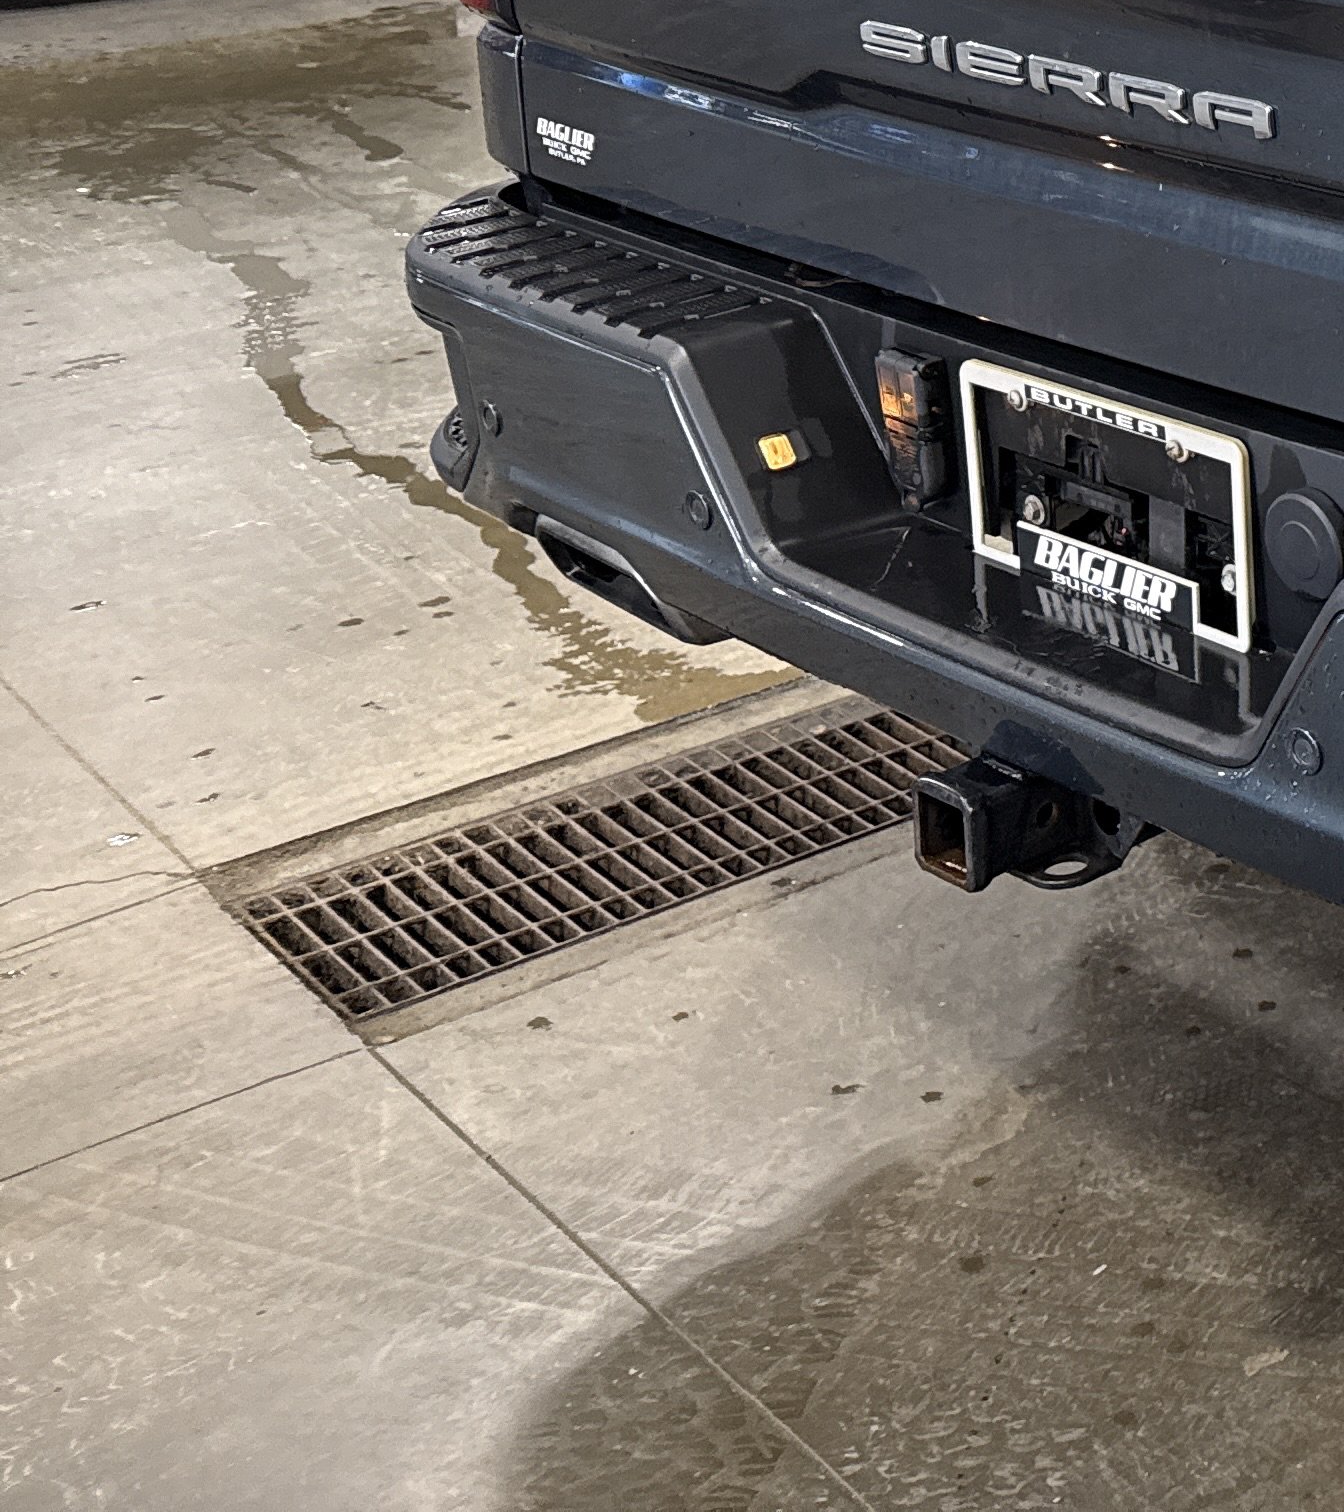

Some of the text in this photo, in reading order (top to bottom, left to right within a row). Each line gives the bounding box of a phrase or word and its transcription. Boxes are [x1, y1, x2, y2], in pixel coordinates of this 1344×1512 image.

[860, 20, 1277, 140] SIERRA
[536, 117, 595, 151] BAGLIER
[1030, 387, 1159, 437] BUTLER
[1034, 535, 1177, 613] BAGLIER
[1051, 570, 1162, 621] BUICK GMC
